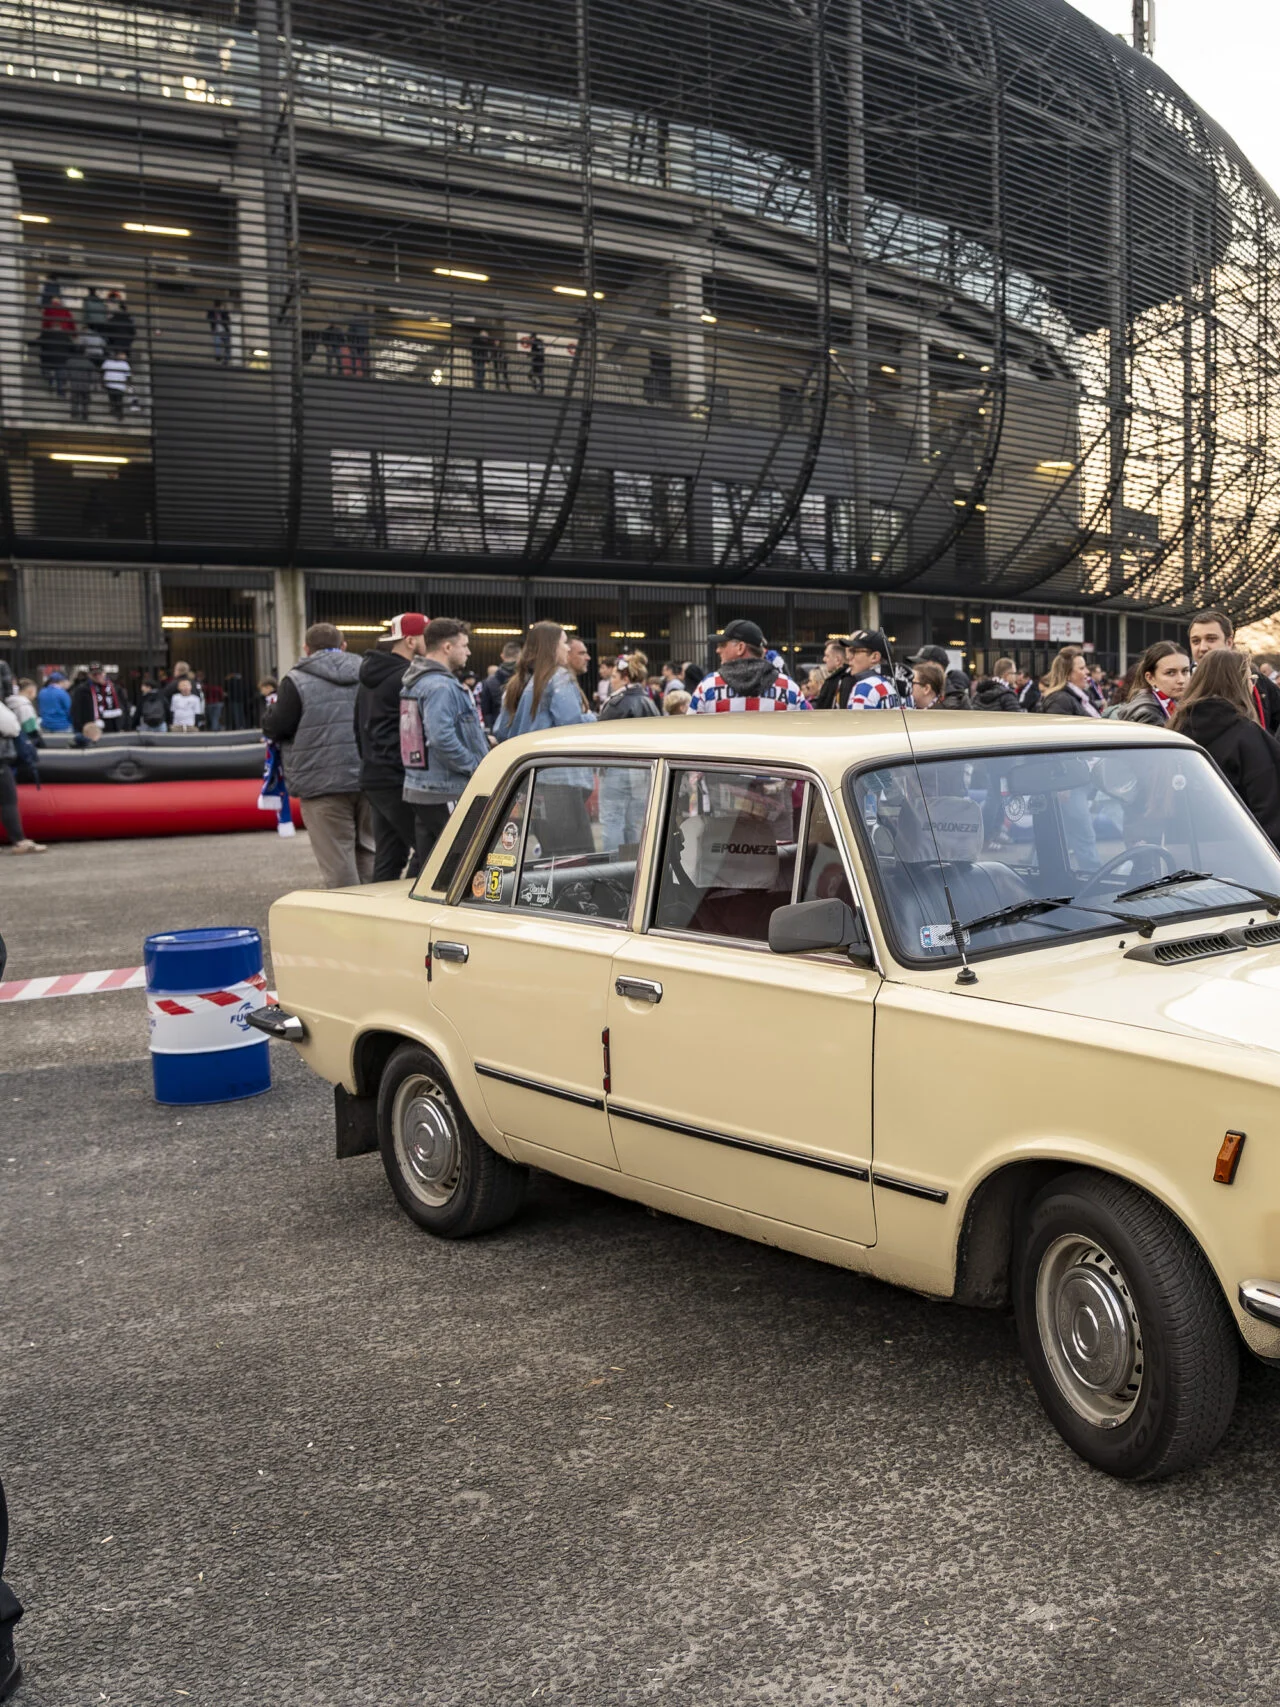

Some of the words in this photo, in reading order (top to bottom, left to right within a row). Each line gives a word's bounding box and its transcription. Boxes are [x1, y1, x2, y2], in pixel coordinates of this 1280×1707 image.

[1009, 618, 1016, 635] 6
[931, 822, 973, 833] POLONEZ
[720, 843, 769, 856] POLONEZ
[490, 871, 499, 891] 5
